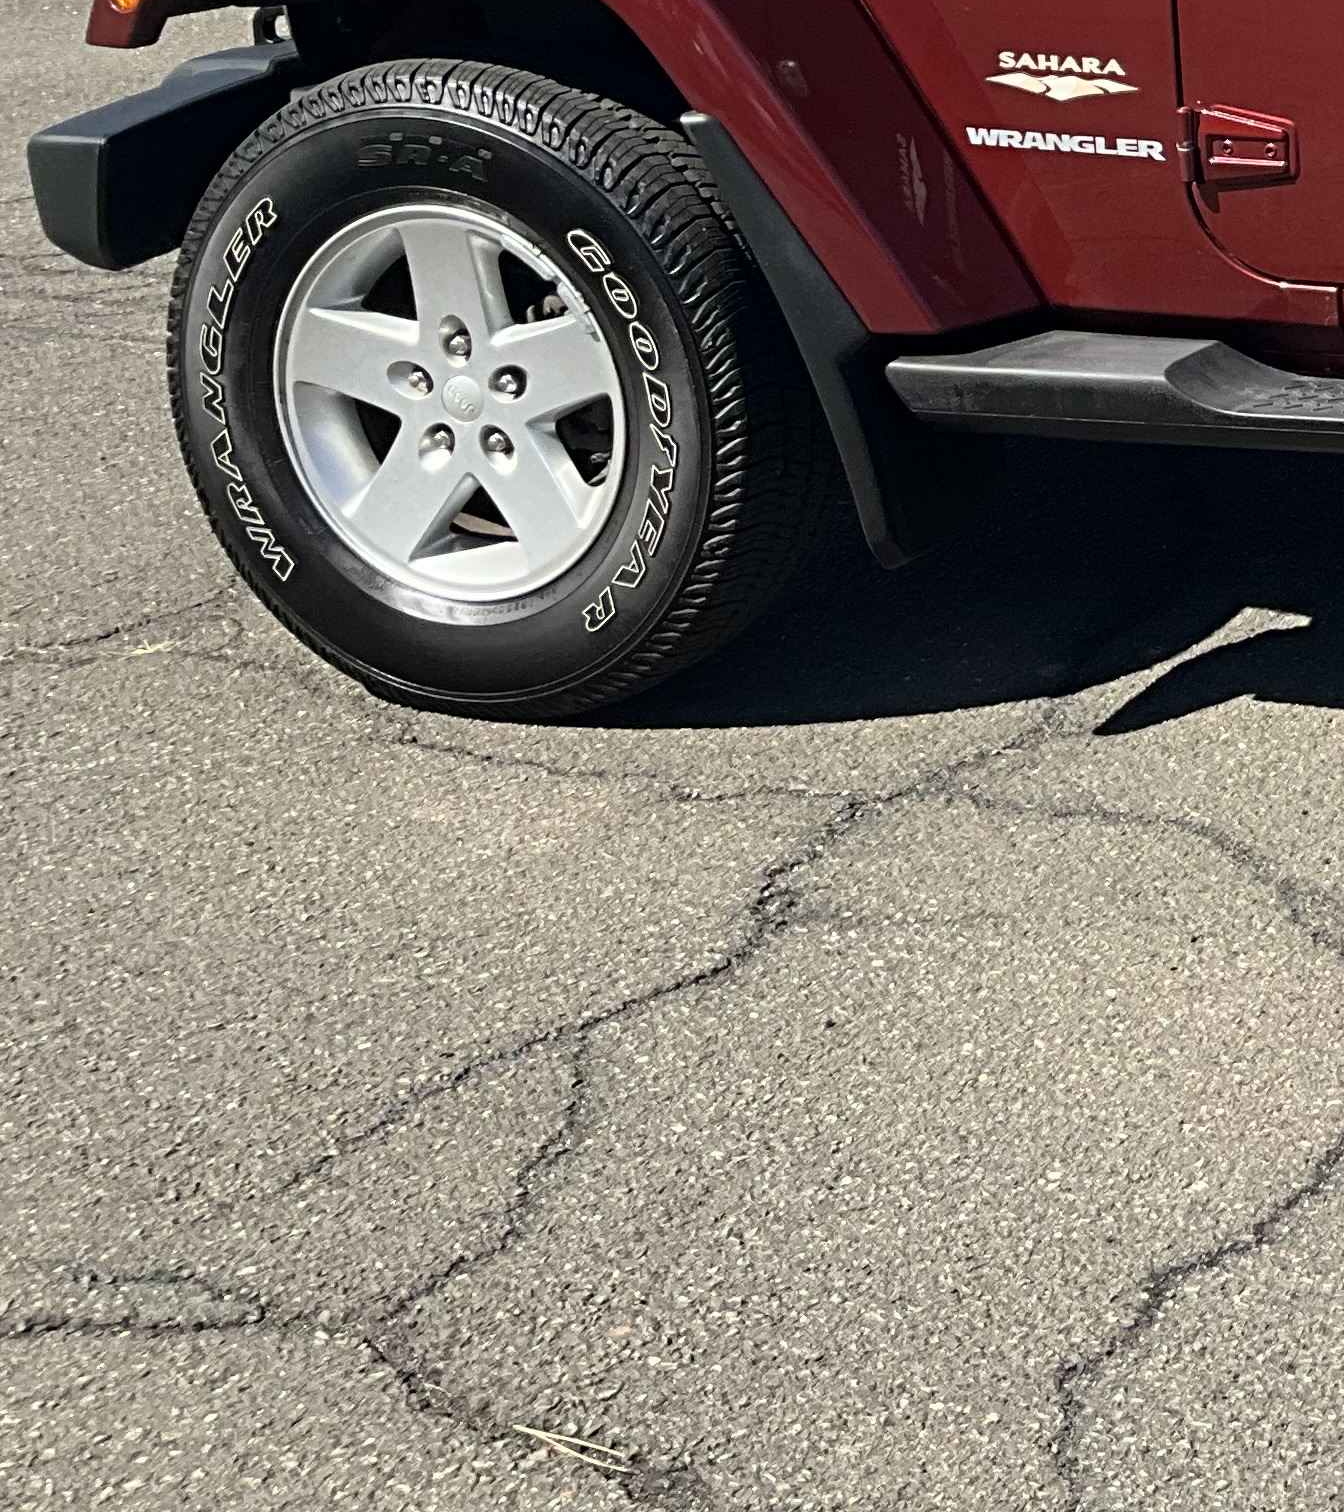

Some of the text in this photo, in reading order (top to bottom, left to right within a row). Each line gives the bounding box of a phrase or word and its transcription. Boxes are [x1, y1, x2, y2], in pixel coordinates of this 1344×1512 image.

[965, 126, 1167, 162] WRANGLER
[998, 51, 1126, 76] SAHARA
[197, 196, 295, 583] WRANGLER
[566, 228, 681, 632] GOODYEAR
